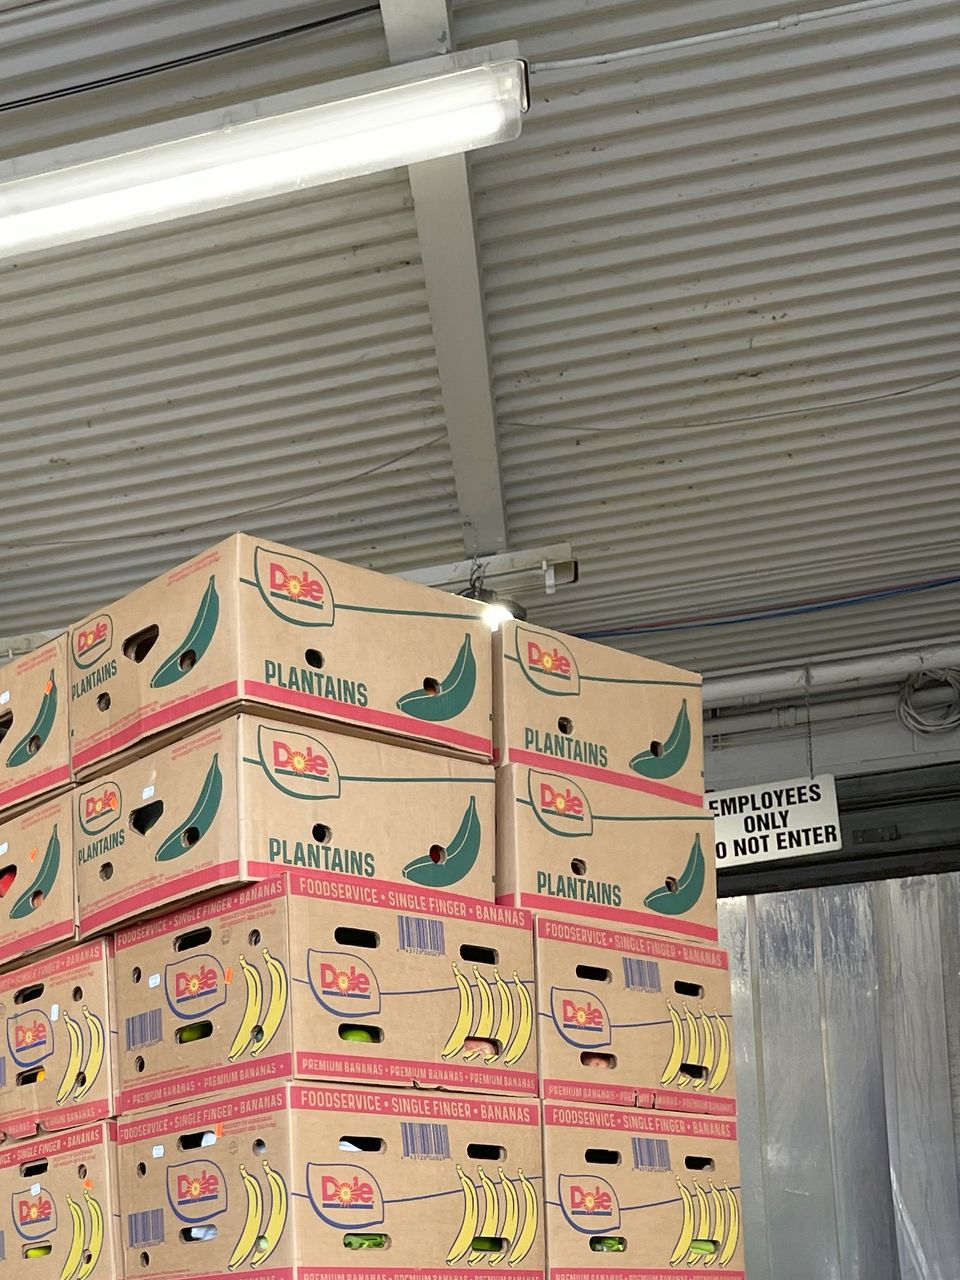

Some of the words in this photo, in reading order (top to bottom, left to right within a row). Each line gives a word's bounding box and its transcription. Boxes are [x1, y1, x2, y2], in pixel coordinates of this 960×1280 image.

[270, 562, 324, 601] Dole
[78, 621, 107, 652] Dole
[527, 641, 571, 675] Dole
[71, 660, 117, 701] PLANTAINS
[265, 660, 369, 707] PLANTAINS
[273, 741, 329, 776] Dole
[525, 727, 608, 768] PLANTAINS
[540, 783, 584, 815] Dole
[709, 783, 822, 818] EMPLOYEES
[743, 810, 790, 833] ONLY
[78, 829, 125, 865] PLANTAINS
[269, 838, 376, 878] PLANTAINS
[715, 842, 727, 859] O
[734, 836, 770, 855] NOT
[777, 825, 838, 851] ENTER
[299, 876, 379, 904] FOODSERVICE
[389, 890, 427, 911] SINGLE
[429, 896, 467, 918] FINGER
[475, 903, 525, 926] BANANAS
[537, 870, 622, 906] PLANTAINS
[118, 918, 167, 946] FOODSERVICE
[173, 907, 201, 929] SINGLE
[203, 896, 232, 919] FINGER
[240, 880, 282, 907] BANANAS
[546, 922, 607, 945] FOODSERVICE
[615, 932, 645, 950] SINGLE
[647, 937, 676, 954] FINGER
[682, 942, 722, 960] BANANAS
[176, 966, 218, 997] Dole
[320, 963, 370, 993] Dole
[563, 1000, 603, 1026] Dole
[15, 1021, 46, 1048] Dole
[133, 1088, 161, 1104] PREMIUM
[162, 1081, 196, 1099] BANANAS
[204, 1072, 238, 1090] PREMIUM
[240, 1063, 277, 1083] BANANAS
[302, 1058, 342, 1074] PREMIUM
[344, 1062, 383, 1077] BANANAS
[389, 1066, 426, 1081] PREMIUM
[428, 1069, 464, 1084] BANANAS
[469, 1073, 502, 1087] PREMIUM
[504, 1076, 535, 1090] BANANAS
[300, 1090, 381, 1112] FOODSERVICE
[391, 1097, 429, 1115] SINGLE
[432, 1100, 470, 1118] FINGER
[481, 1104, 530, 1122] BANANAS
[549, 1086, 581, 1098] PREMIUM
[121, 1118, 168, 1142] FOODSERVICE
[174, 1111, 202, 1130] SINGLE
[203, 1104, 233, 1124] FINGER
[240, 1093, 283, 1116] BANANAS
[553, 1108, 616, 1128] FOODSERVICE
[623, 1114, 653, 1131] SINGLE
[655, 1117, 685, 1134] FINGER
[692, 1120, 731, 1138] BANANAS
[38, 1139, 61, 1156] FINGER
[68, 1130, 100, 1147] BANANAS
[177, 1171, 218, 1200] Dole
[322, 1176, 373, 1203] Dole
[570, 1185, 613, 1210] Dole
[20, 1197, 52, 1221] Dole
